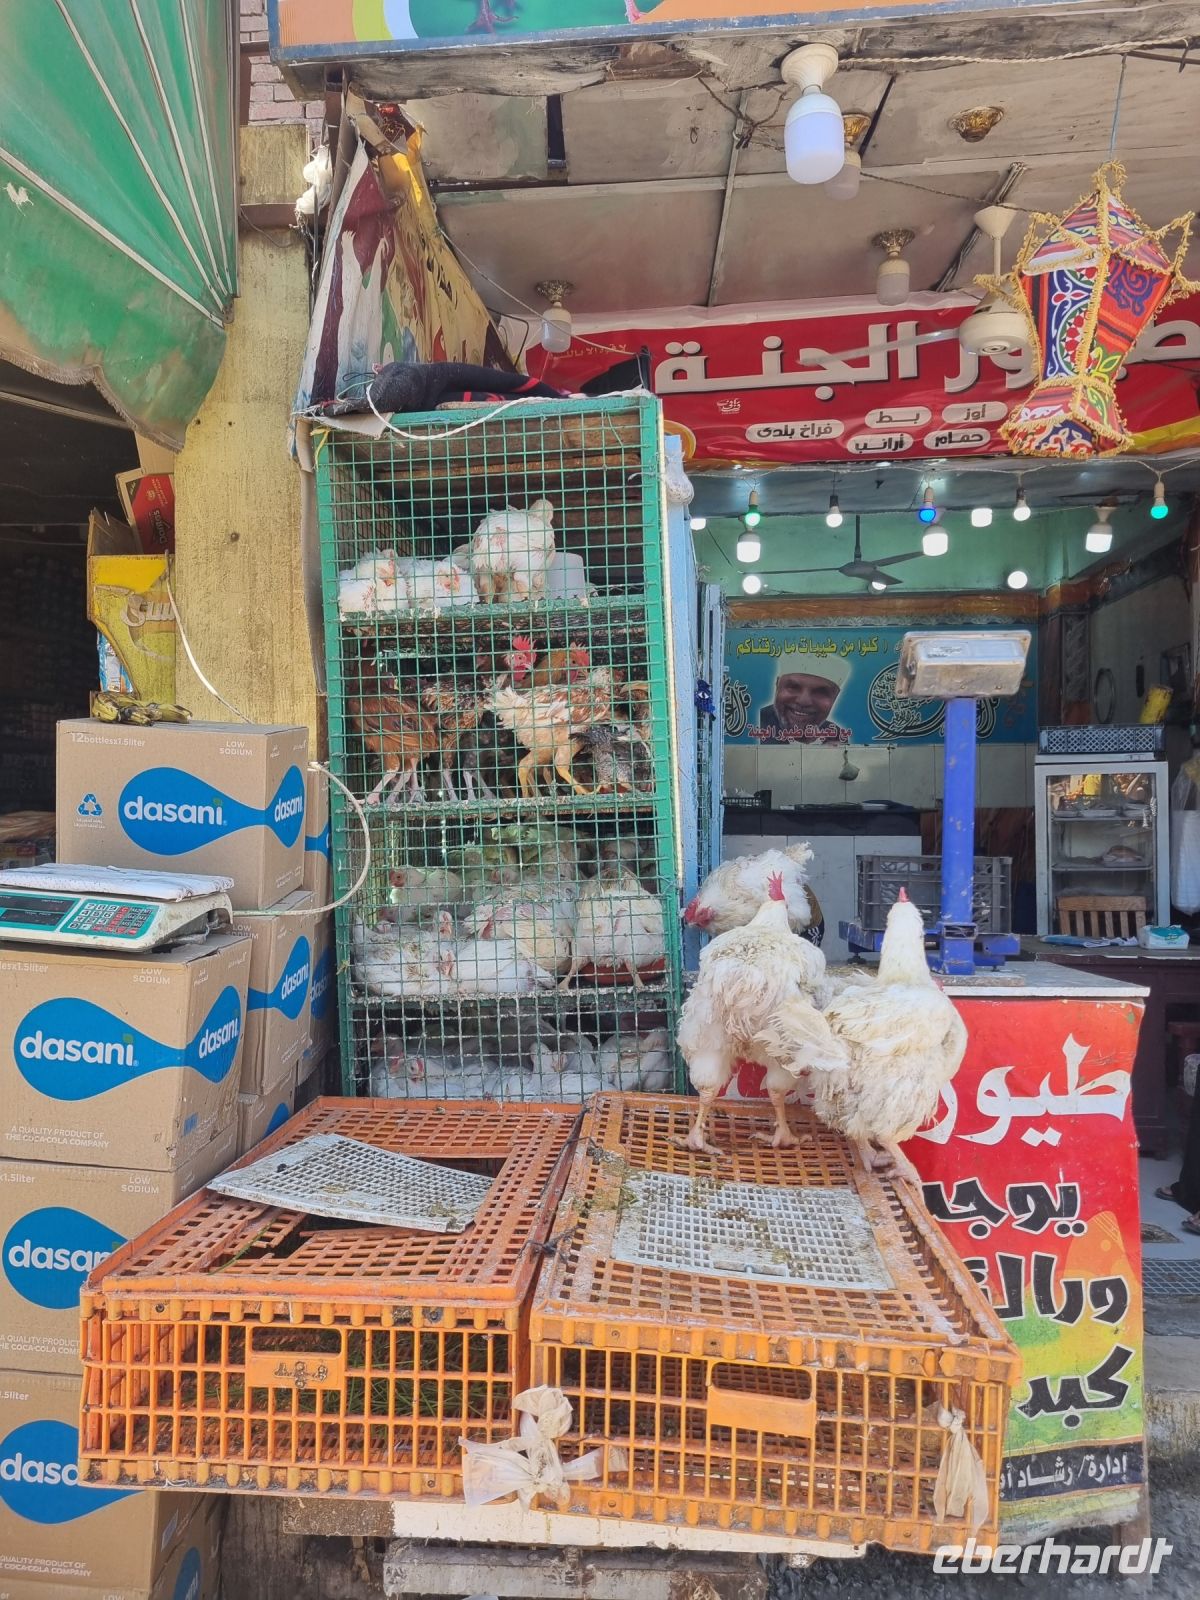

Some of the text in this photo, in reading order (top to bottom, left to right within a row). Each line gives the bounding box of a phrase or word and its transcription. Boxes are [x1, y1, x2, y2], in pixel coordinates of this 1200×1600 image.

[655, 320, 920, 400] الجنة
[799, 422, 834, 438] فراخ
[854, 432, 906, 452] أرانب
[933, 430, 984, 448] حمام
[736, 637, 782, 658] رزقناكم
[840, 640, 855, 657] من
[858, 636, 879, 657] كلوا
[219, 747, 253, 756] SODIUM
[226, 740, 245, 748] LOW
[123, 795, 223, 826] dasani
[274, 795, 303, 823] dasani
[132, 975, 171, 985] SODIUM
[141, 967, 163, 976] LOW
[281, 963, 309, 1001] dasani
[198, 1017, 239, 1059] dasani
[19, 1030, 135, 1067] dasani
[913, 1032, 1132, 1147] طيور
[6, 1132, 22, 1141] THE
[69, 1138, 110, 1149] COMPANY
[18, 1126, 54, 1136] QUALITY
[54, 1129, 92, 1139] PRODUCT
[93, 1131, 105, 1140] OF
[129, 1175, 151, 1185] LOW
[121, 1184, 160, 1194] SODIUM
[6, 1334, 42, 1345] QUALITY
[1017, 1455, 1074, 1488] رشاد
[34, 1558, 74, 1568] PRODUCT
[74, 1561, 87, 1569] OF
[51, 1567, 92, 1577] COMPANY
